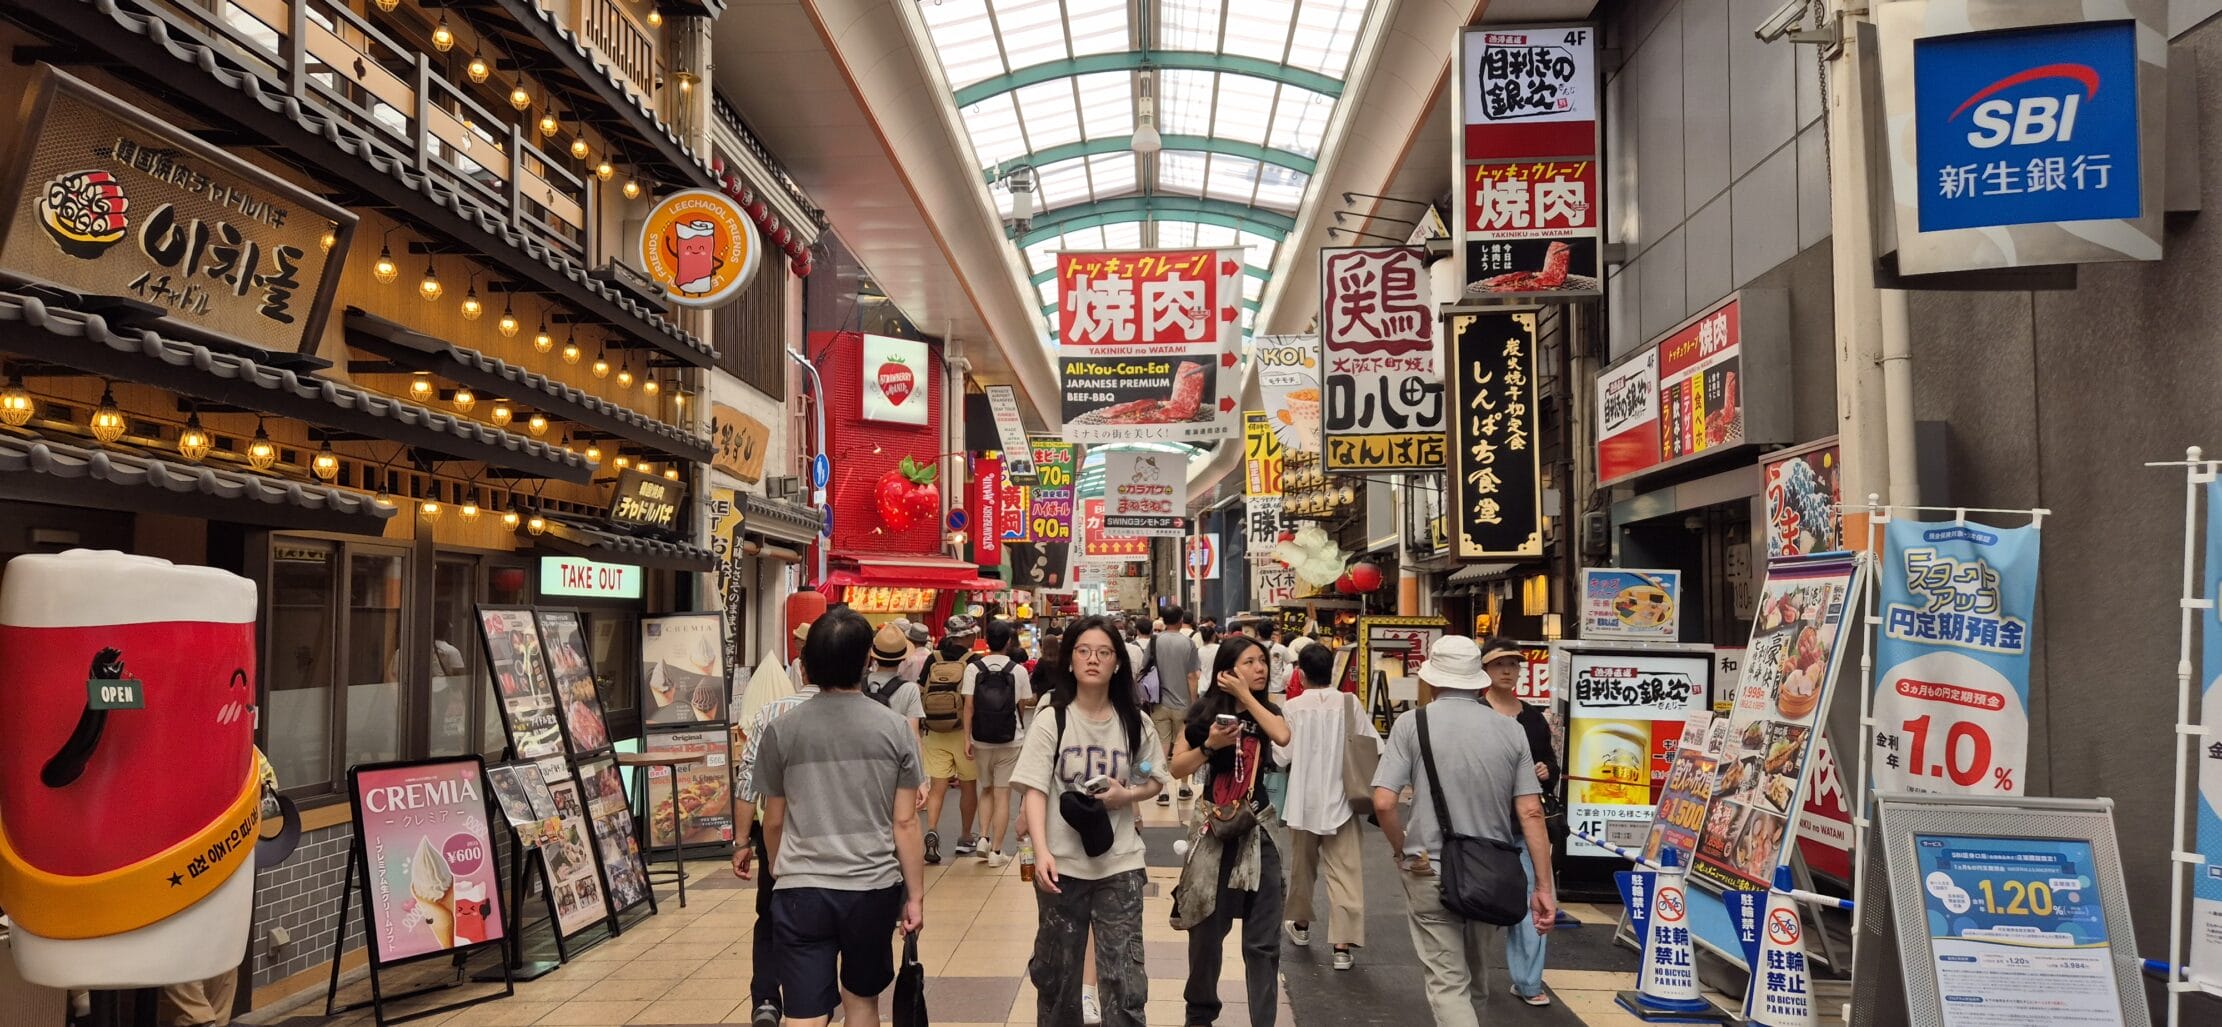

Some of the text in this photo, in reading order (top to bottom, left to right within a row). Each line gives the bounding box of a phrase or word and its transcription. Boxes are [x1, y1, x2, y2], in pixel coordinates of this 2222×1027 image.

[1564, 31, 1586, 46] 4F
[1487, 47, 1576, 83] 目利きの
[1486, 79, 1558, 116] 銀次
[1967, 94, 2080, 148] SBI
[1475, 161, 1588, 182] トッキュウレーン
[1938, 154, 2112, 199] 新生銀行
[1475, 176, 1586, 230] 焼肉
[668, 199, 742, 264] LEECHADOL FRIENDS
[139, 203, 304, 324] 이차돌
[649, 232, 667, 278] FRIENDS
[1481, 244, 1489, 270] しよう
[1066, 254, 1208, 279] トッキュウレーン
[128, 270, 210, 316] イチャドル
[1337, 252, 1432, 339] 鶏
[1066, 272, 1206, 343] 焼肉
[1699, 313, 1728, 358] 焼肉
[1089, 347, 1134, 356] YAKINIKU
[1149, 346, 1187, 355] WATAMI
[1263, 346, 1305, 366] KOI
[1646, 354, 1655, 369] 4F
[1066, 362, 1170, 376] All-You-Can-Eat
[1066, 378, 1170, 389] JAPANESE PREMIUM
[1066, 392, 1115, 403] BEEF-BBQ
[1330, 436, 1446, 466] なんば店
[1468, 360, 1503, 525] しんぱち食堂
[1033, 447, 1071, 465] 生ビール
[1125, 484, 1165, 495] カラオケ
[1032, 501, 1071, 517] ハイボール
[1117, 498, 1173, 514] まねきねこ
[982, 504, 995, 551] STRAWBERRY
[1033, 518, 1070, 538] 90円
[561, 563, 624, 591] TAKE OUT
[1908, 556, 1996, 591] スタート
[1929, 586, 1998, 614] アップ
[1888, 608, 2026, 650] 円定期預金
[100, 686, 134, 703] OPEN
[1576, 677, 1691, 705] 目利きの銀次
[672, 734, 703, 742] Original
[1875, 732, 1899, 751] 金利
[1885, 752, 1899, 770] 年
[366, 779, 479, 814] CREMIA
[402, 810, 450, 829] クレミア
[1602, 809, 1617, 817] 170
[1820, 826, 1845, 841] WATAMI
[447, 846, 482, 864] ¥600
[1631, 874, 1645, 920] 駐輪禁止
[1741, 893, 1755, 942] 駐輪禁止
[1655, 927, 1689, 946] 駐輪
[1655, 947, 1691, 967] 禁止
[1766, 949, 1805, 972] 駐輪
[1655, 967, 1691, 978] NO BICYCLE
[1655, 977, 1692, 988] PARKING
[1766, 973, 1807, 994] 禁止
[1766, 994, 1808, 1006] NO BICYCLE
[1766, 1005, 1808, 1017] PARKING
